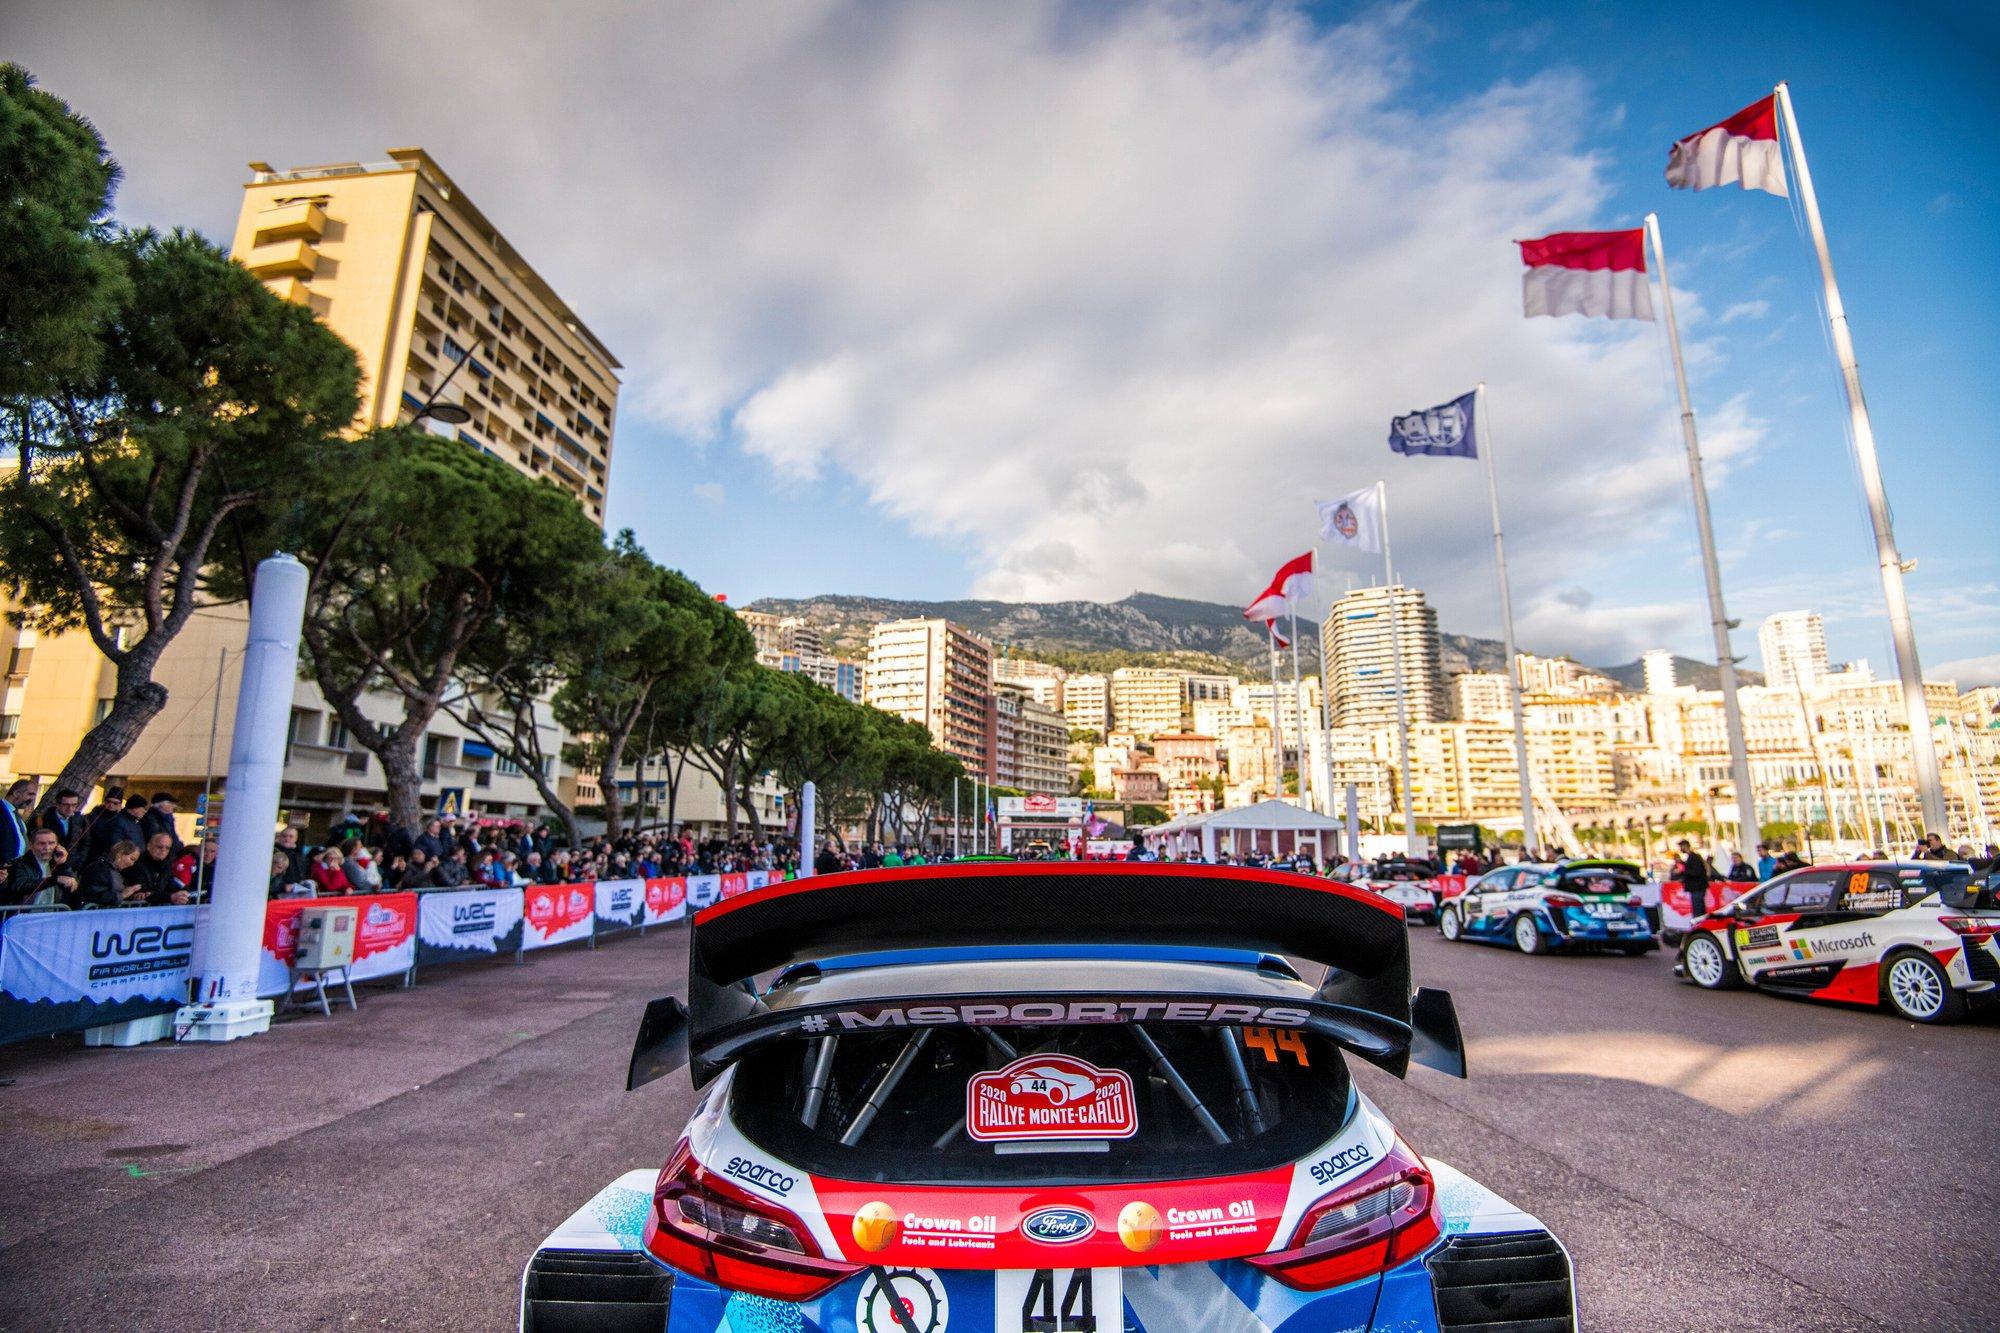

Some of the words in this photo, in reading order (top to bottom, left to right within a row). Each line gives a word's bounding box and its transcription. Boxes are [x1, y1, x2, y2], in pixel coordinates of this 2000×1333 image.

[1848, 872, 1870, 894] 69
[453, 901, 496, 922] WRC
[92, 923, 194, 958] WRC
[1810, 932, 1876, 954] Microsoft
[90, 968, 187, 988] CHAMPIONSHIP
[113, 962, 151, 975] WORLD
[1243, 1026, 1310, 1067] 44
[980, 1083, 1006, 1102] 2020
[1031, 1079, 1047, 1092] 44
[1095, 1081, 1121, 1101] 2020
[979, 1095, 1024, 1127] RALLYE
[1029, 1093, 1125, 1125] MONTE-CARLO
[1310, 1144, 1370, 1182] sparco
[727, 1156, 794, 1192] sparco
[1167, 1206, 1224, 1224] Crown
[1228, 1199, 1256, 1218] Oil
[903, 1212, 962, 1231] Crown
[968, 1215, 997, 1233] Oil
[1038, 1214, 1078, 1235] Ford
[1169, 1230, 1193, 1241] Fuels
[1195, 1228, 1213, 1237] and
[1214, 1224, 1258, 1236] Lubricants
[902, 1236, 926, 1246] Fuels
[928, 1238, 946, 1247] and
[948, 1238, 996, 1249] Lubricants
[1022, 1268, 1097, 1333] 44
